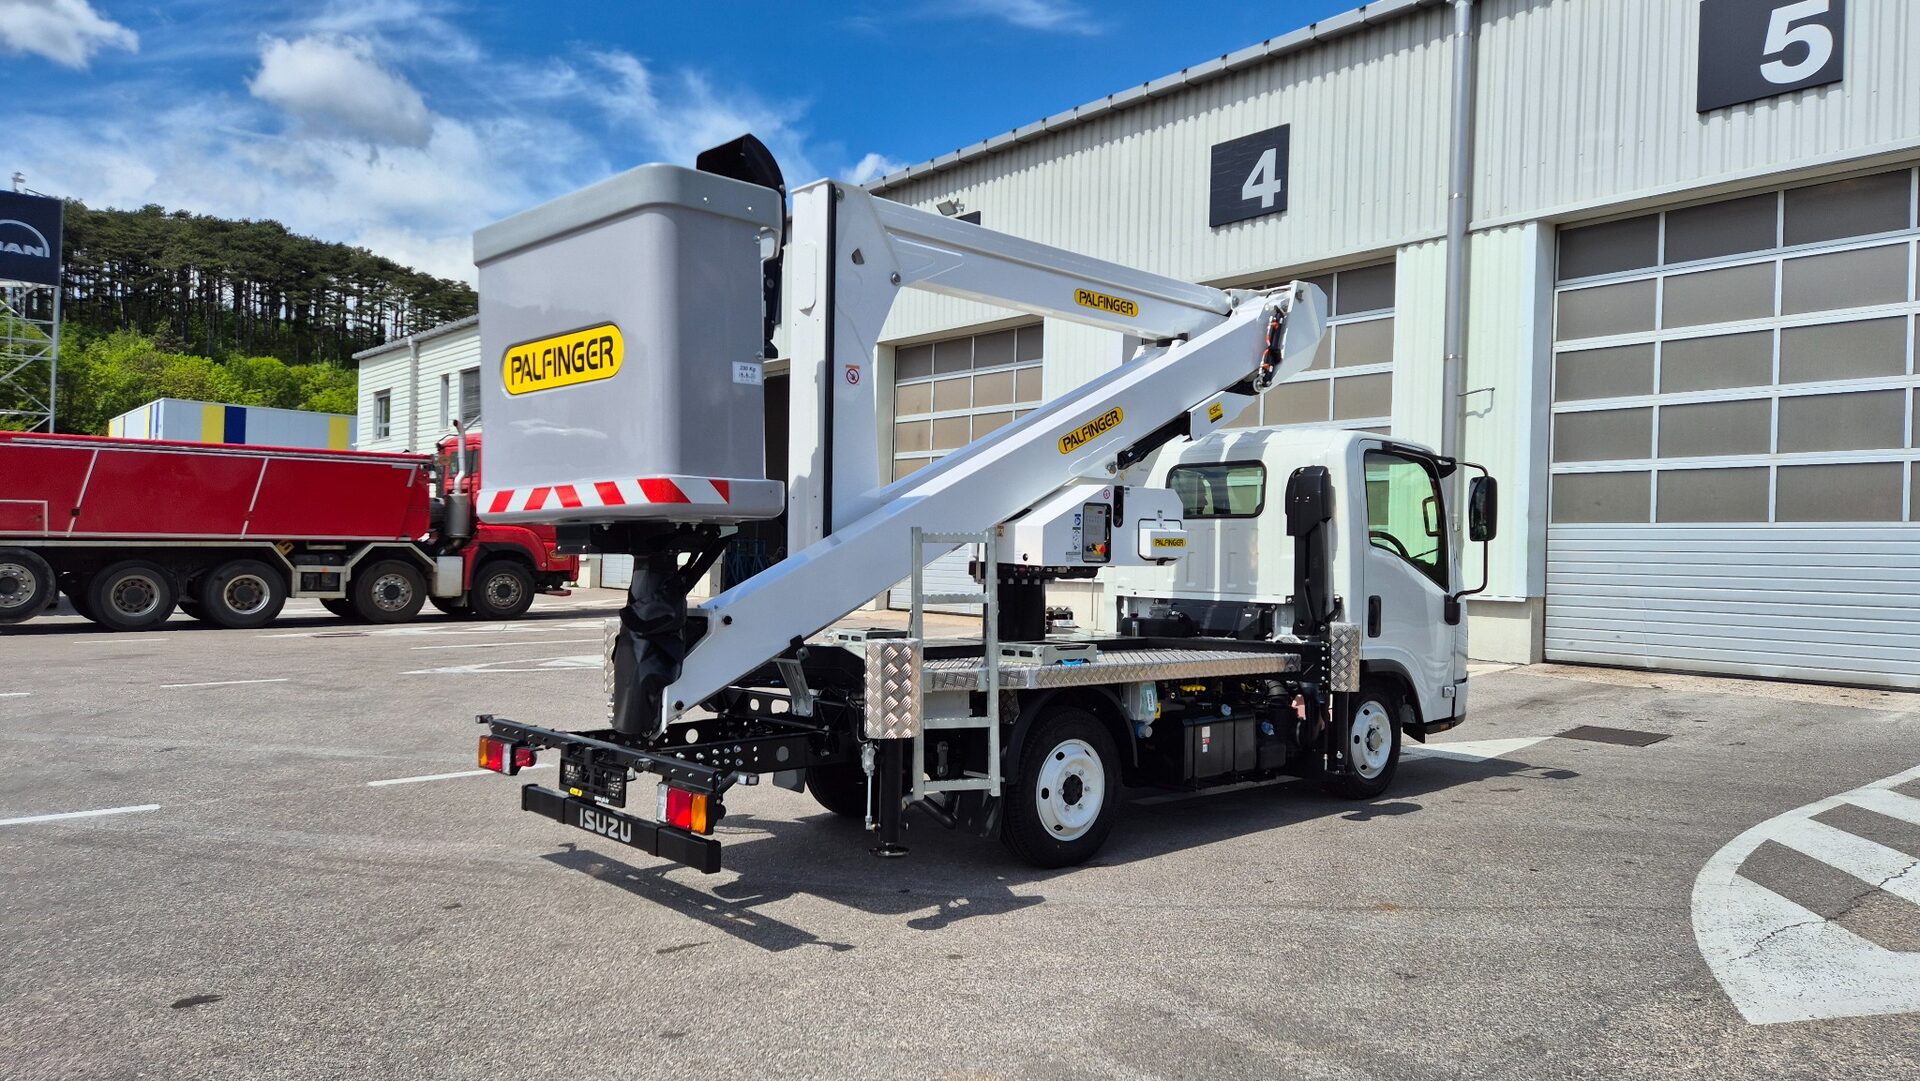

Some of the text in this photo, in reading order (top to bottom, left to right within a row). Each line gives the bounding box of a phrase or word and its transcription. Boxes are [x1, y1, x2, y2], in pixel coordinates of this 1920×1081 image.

[1760, 0, 1833, 84] 5
[1242, 148, 1281, 208] 4
[0, 241, 44, 257] AN
[1079, 290, 1134, 315] PALFINGER
[511, 335, 614, 386] PALFINGER
[1062, 410, 1120, 451] PALFINGER
[1154, 538, 1185, 547] PALFINGER
[580, 808, 632, 843] ISUZU
